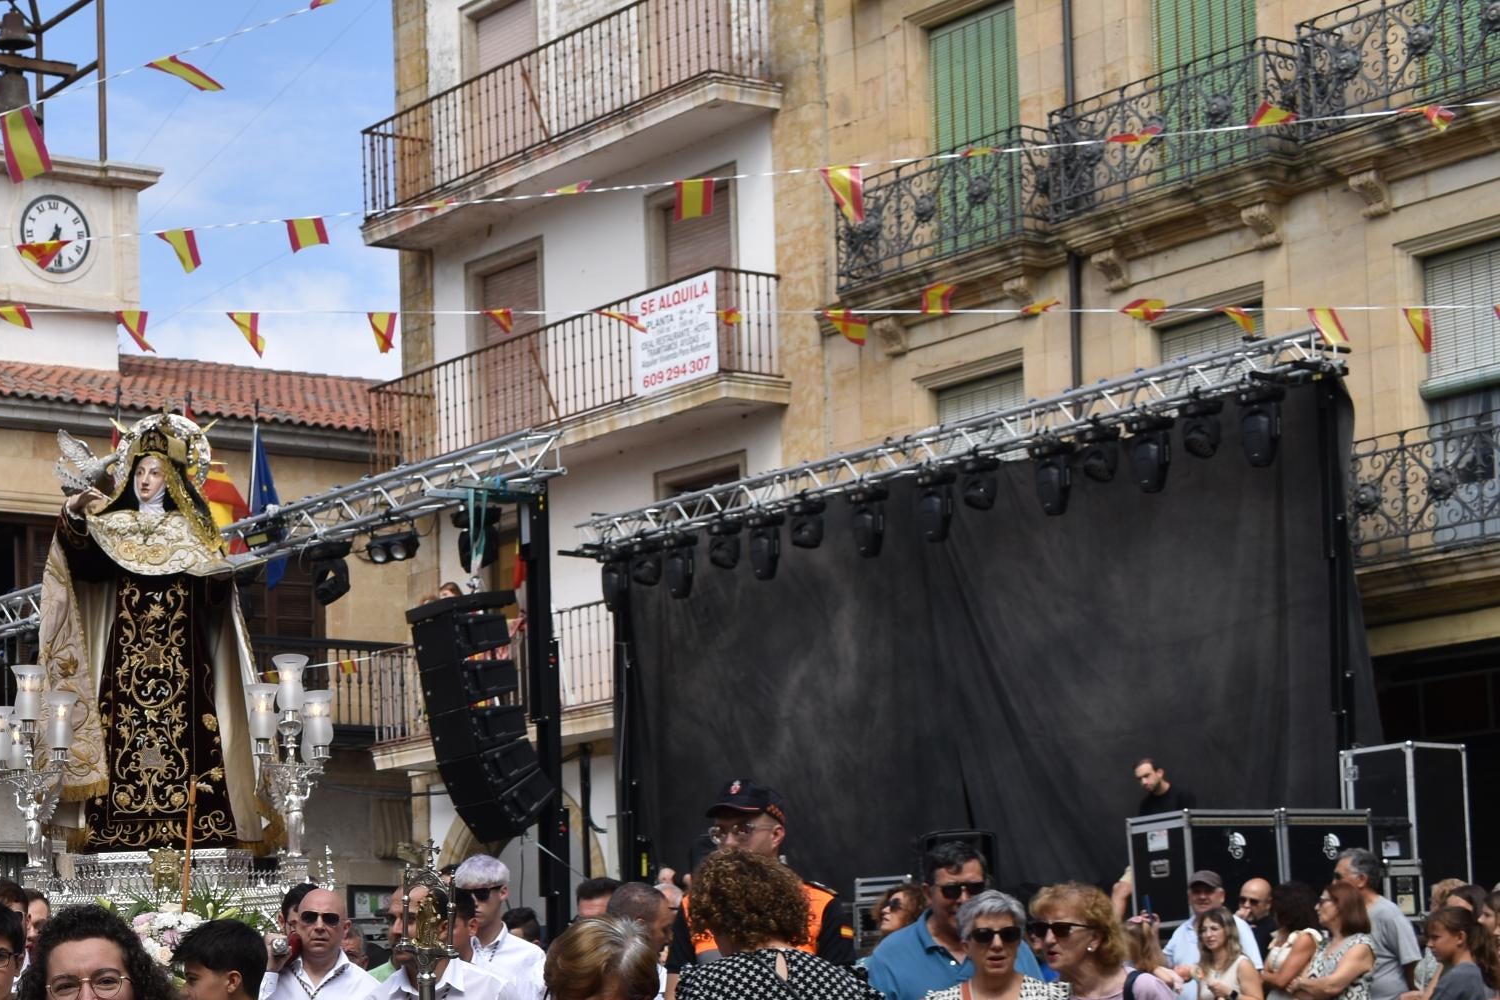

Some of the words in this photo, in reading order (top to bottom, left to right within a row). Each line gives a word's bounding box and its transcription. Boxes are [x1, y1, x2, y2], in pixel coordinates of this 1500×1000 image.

[641, 299, 655, 316] SE
[659, 281, 708, 310] ALQUILA
[643, 370, 664, 389] 609
[666, 363, 687, 382] 294
[689, 355, 711, 374] 307
